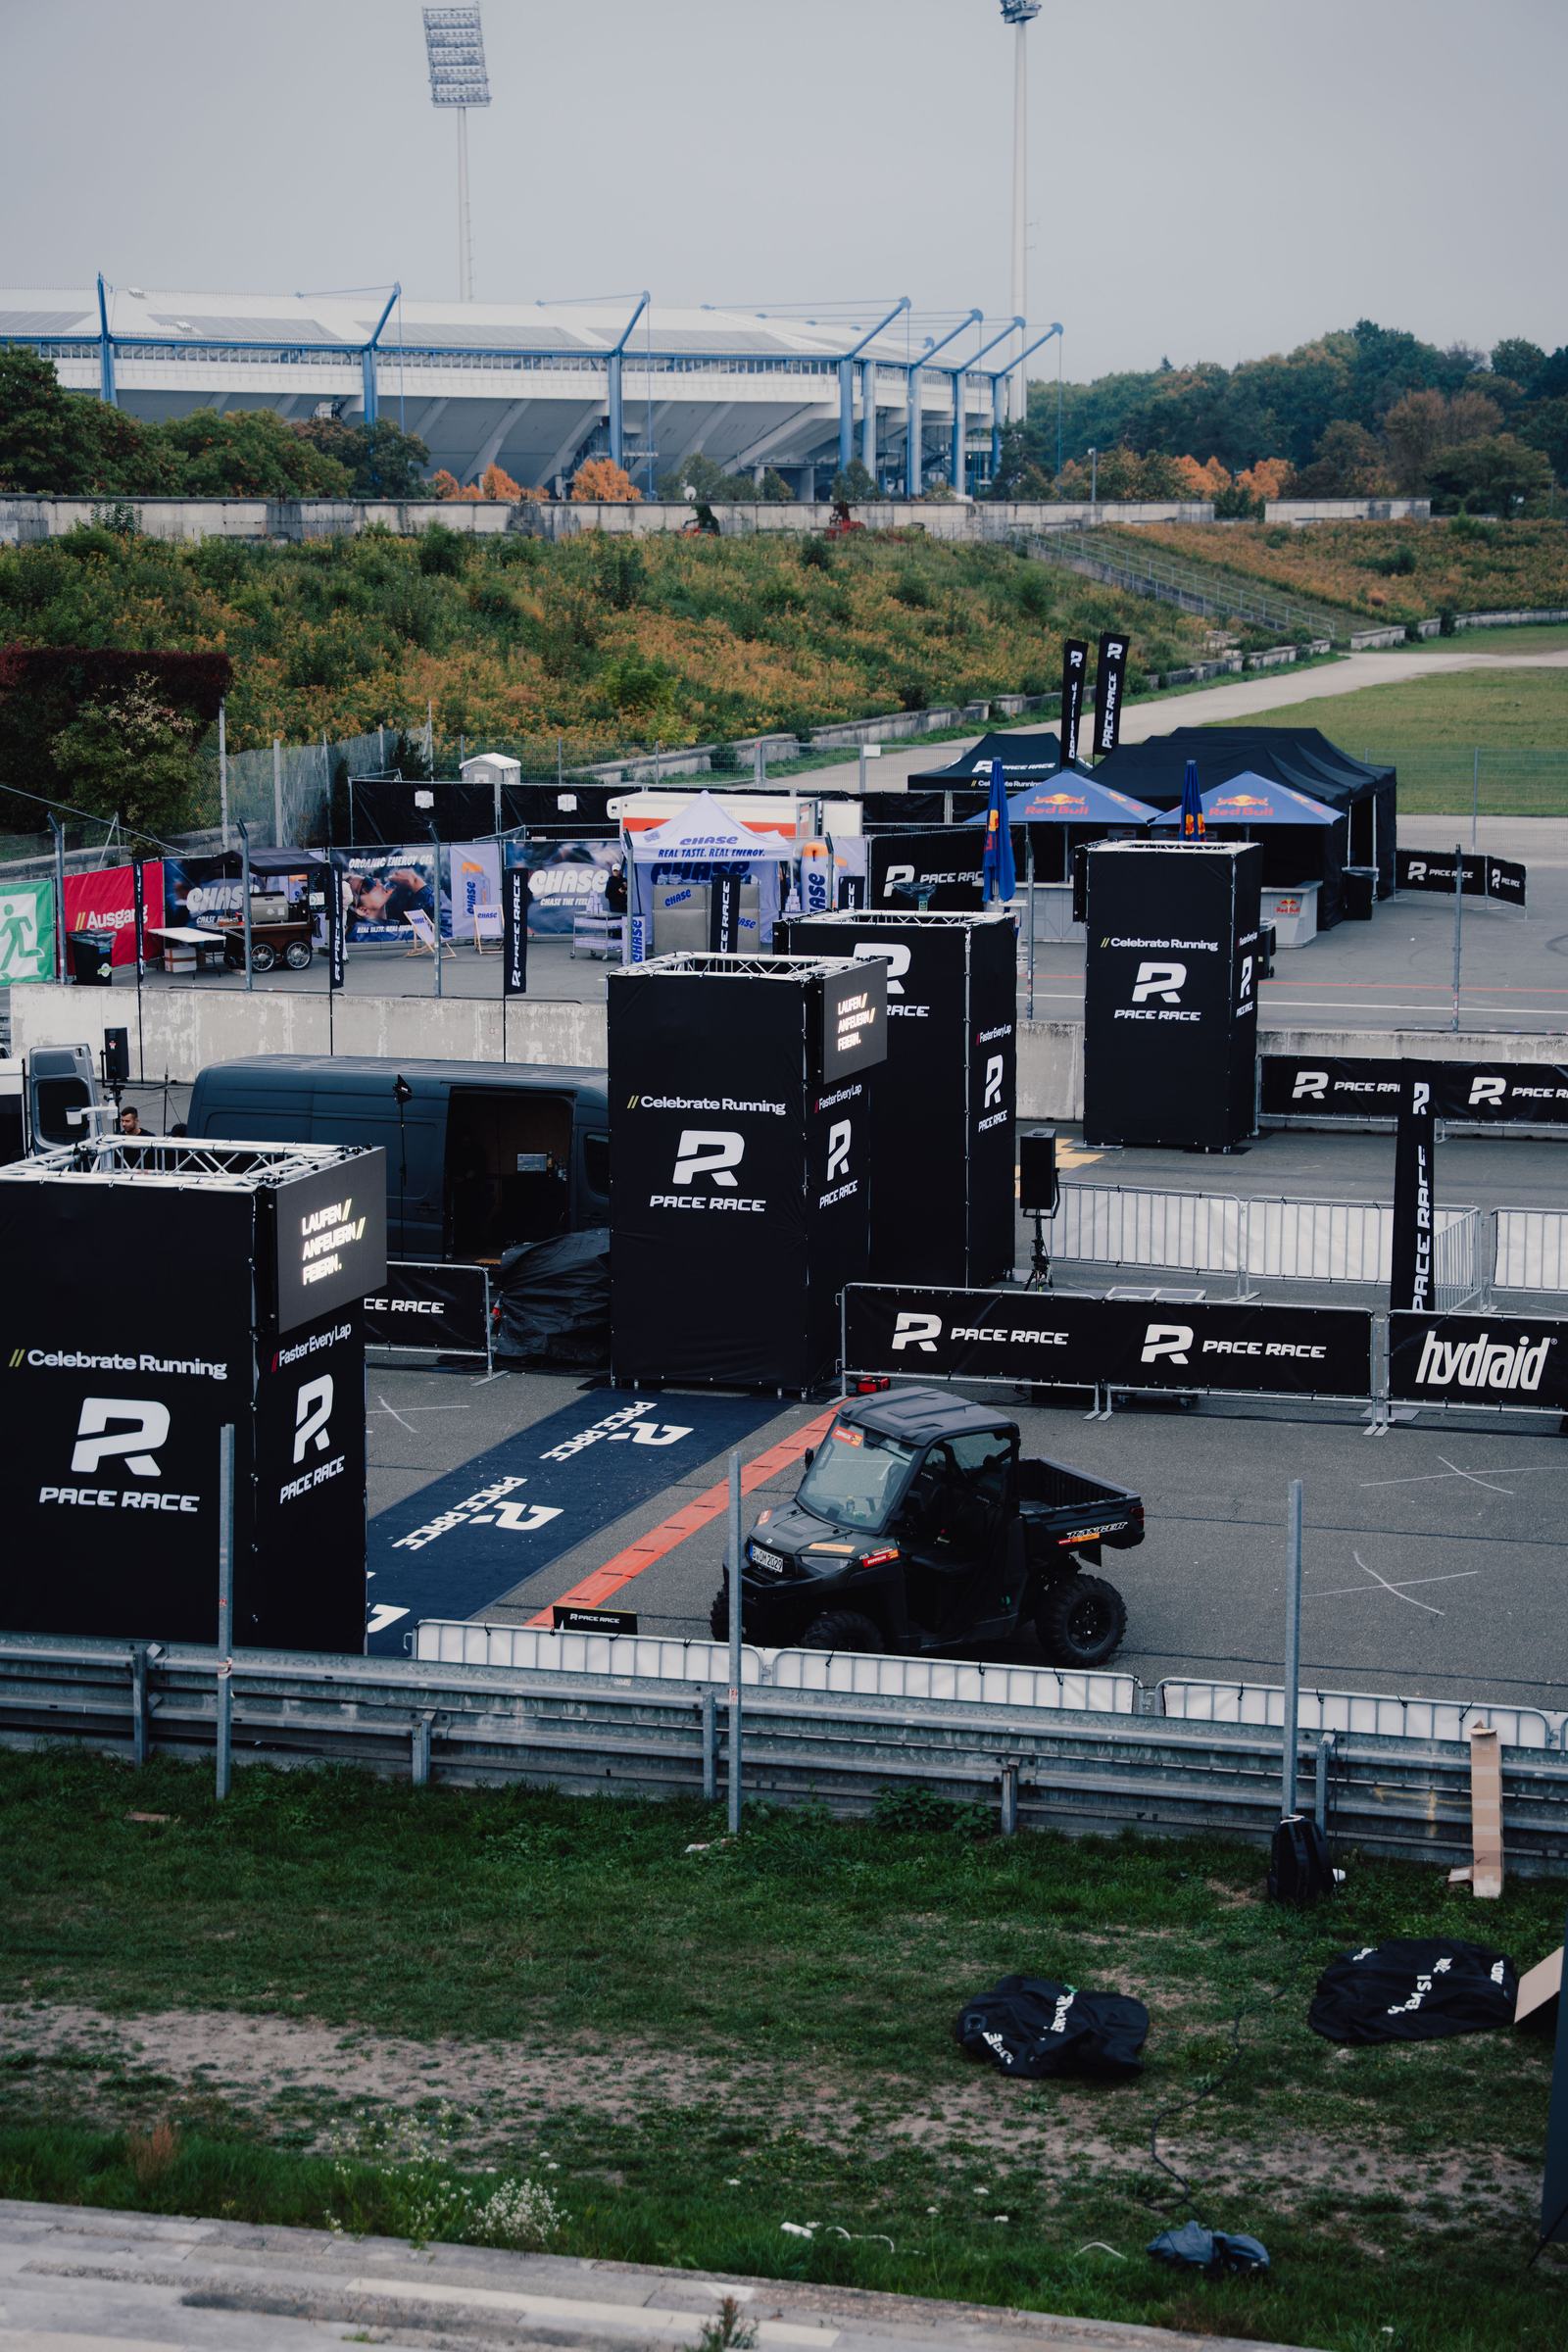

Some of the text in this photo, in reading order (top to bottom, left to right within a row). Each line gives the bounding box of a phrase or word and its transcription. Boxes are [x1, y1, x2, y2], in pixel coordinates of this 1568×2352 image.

[1102, 671, 1117, 749] PACE RACE
[1025, 806, 1089, 815] Red Bull
[1208, 807, 1274, 816] Red Bull
[679, 836, 739, 846] CHASE
[349, 858, 386, 869] ORGANIC
[387, 856, 417, 867] ENERGY
[659, 849, 765, 858] REAL TASTE. REAL ENERGY.
[528, 869, 610, 894] CHASE
[919, 873, 956, 884] PACE
[957, 871, 984, 882] RAC
[1451, 870, 1474, 879] RCE
[513, 874, 521, 921] RACE
[540, 898, 562, 906] CHASE
[665, 889, 692, 907] CHASE
[808, 873, 825, 913] ASE
[738, 916, 757, 929] ASE
[1110, 937, 1169, 950] Celebrate
[1170, 939, 1218, 952] Running
[1114, 1009, 1201, 1021] PACE RACE
[1004, 1024, 1012, 1037] Lap
[1334, 1081, 1375, 1093] PACE
[1377, 1083, 1400, 1093] RA
[1511, 1087, 1554, 1098] PACE
[640, 1096, 720, 1110] Celebrate
[721, 1098, 786, 1115] Running
[818, 1095, 837, 1110] Faster
[836, 1088, 853, 1103] Every
[851, 1084, 862, 1097] Lap
[978, 1109, 1007, 1133] PACE RACE
[649, 1195, 766, 1212] PACE RACE
[818, 1180, 858, 1209] PACE RACE
[1412, 1145, 1431, 1311] PACE RACE
[364, 1298, 445, 1314] CE RACE
[278, 1343, 309, 1367] Faster
[309, 1330, 336, 1353] Every
[334, 1323, 352, 1343] Lap
[951, 1327, 1008, 1343] PACE
[1010, 1330, 1069, 1346] RACE
[1202, 1340, 1263, 1355] PACE
[1265, 1343, 1327, 1358] RACE
[27, 1349, 137, 1371] Celebrate
[139, 1354, 227, 1380] Running
[539, 1400, 658, 1462] PACE RACE
[280, 1455, 345, 1504] PACE RACE
[39, 1487, 200, 1512] PACE RACE
[391, 1476, 528, 1550] PACE RACE
